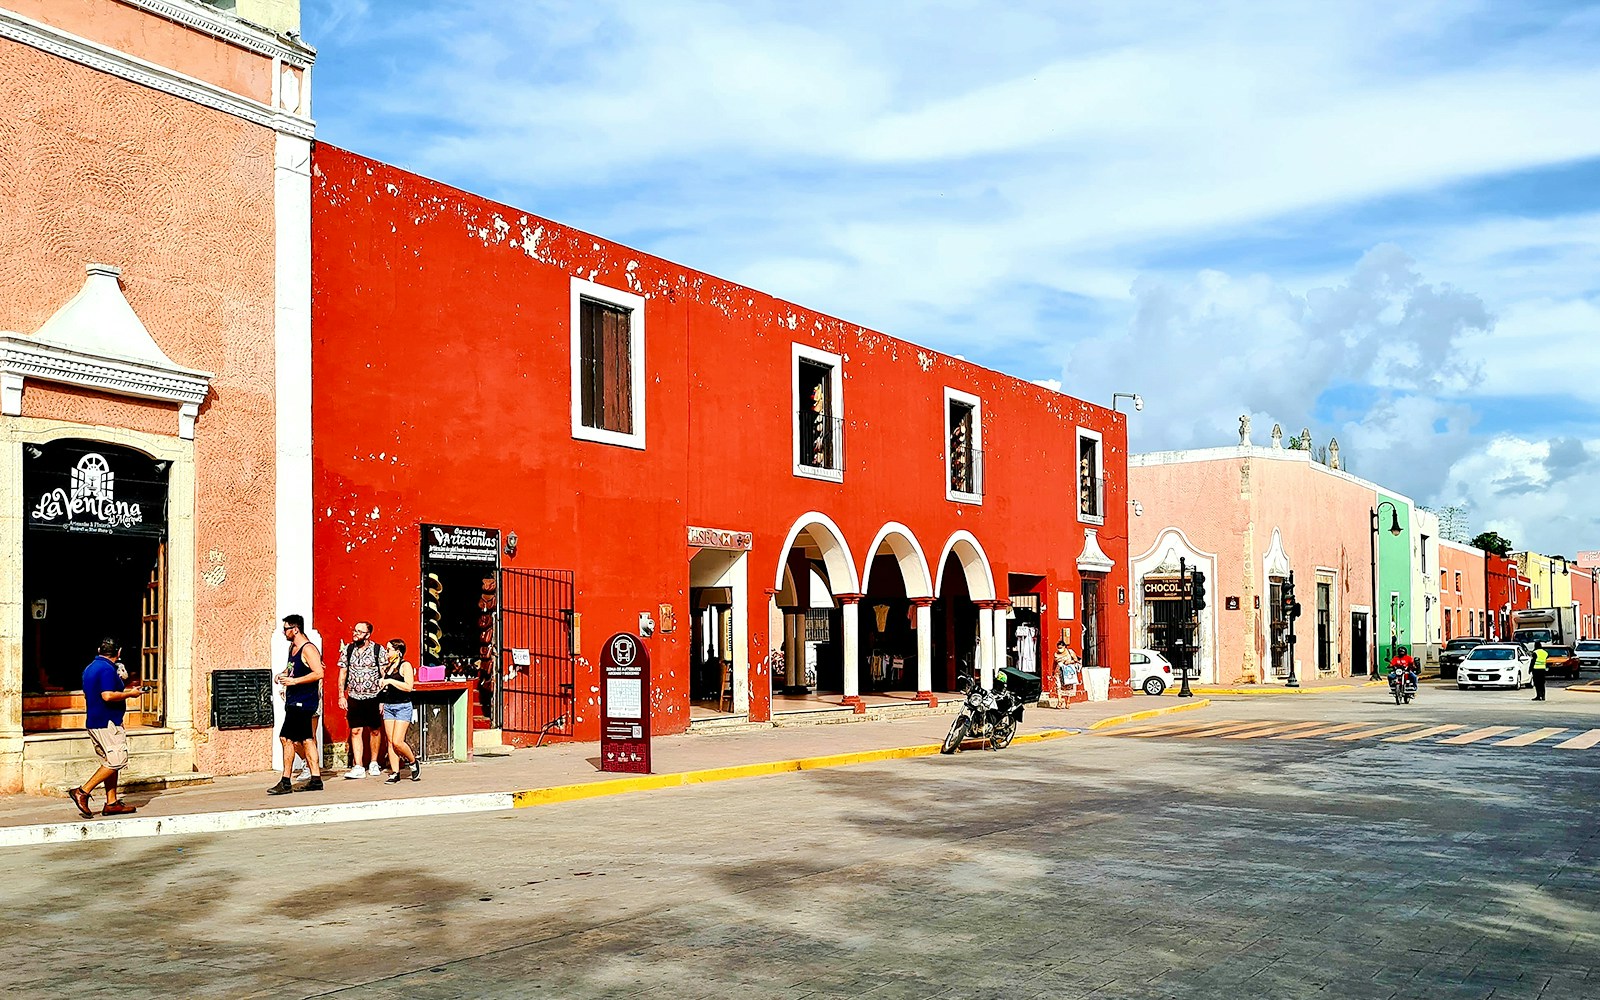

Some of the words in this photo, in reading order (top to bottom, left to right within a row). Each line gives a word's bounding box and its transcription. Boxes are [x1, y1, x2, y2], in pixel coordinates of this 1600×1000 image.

[32, 492, 63, 520] La
[52, 485, 142, 520] Ventana
[454, 527, 471, 536] Casa
[471, 528, 478, 536] de
[691, 529, 718, 546] HSBC
